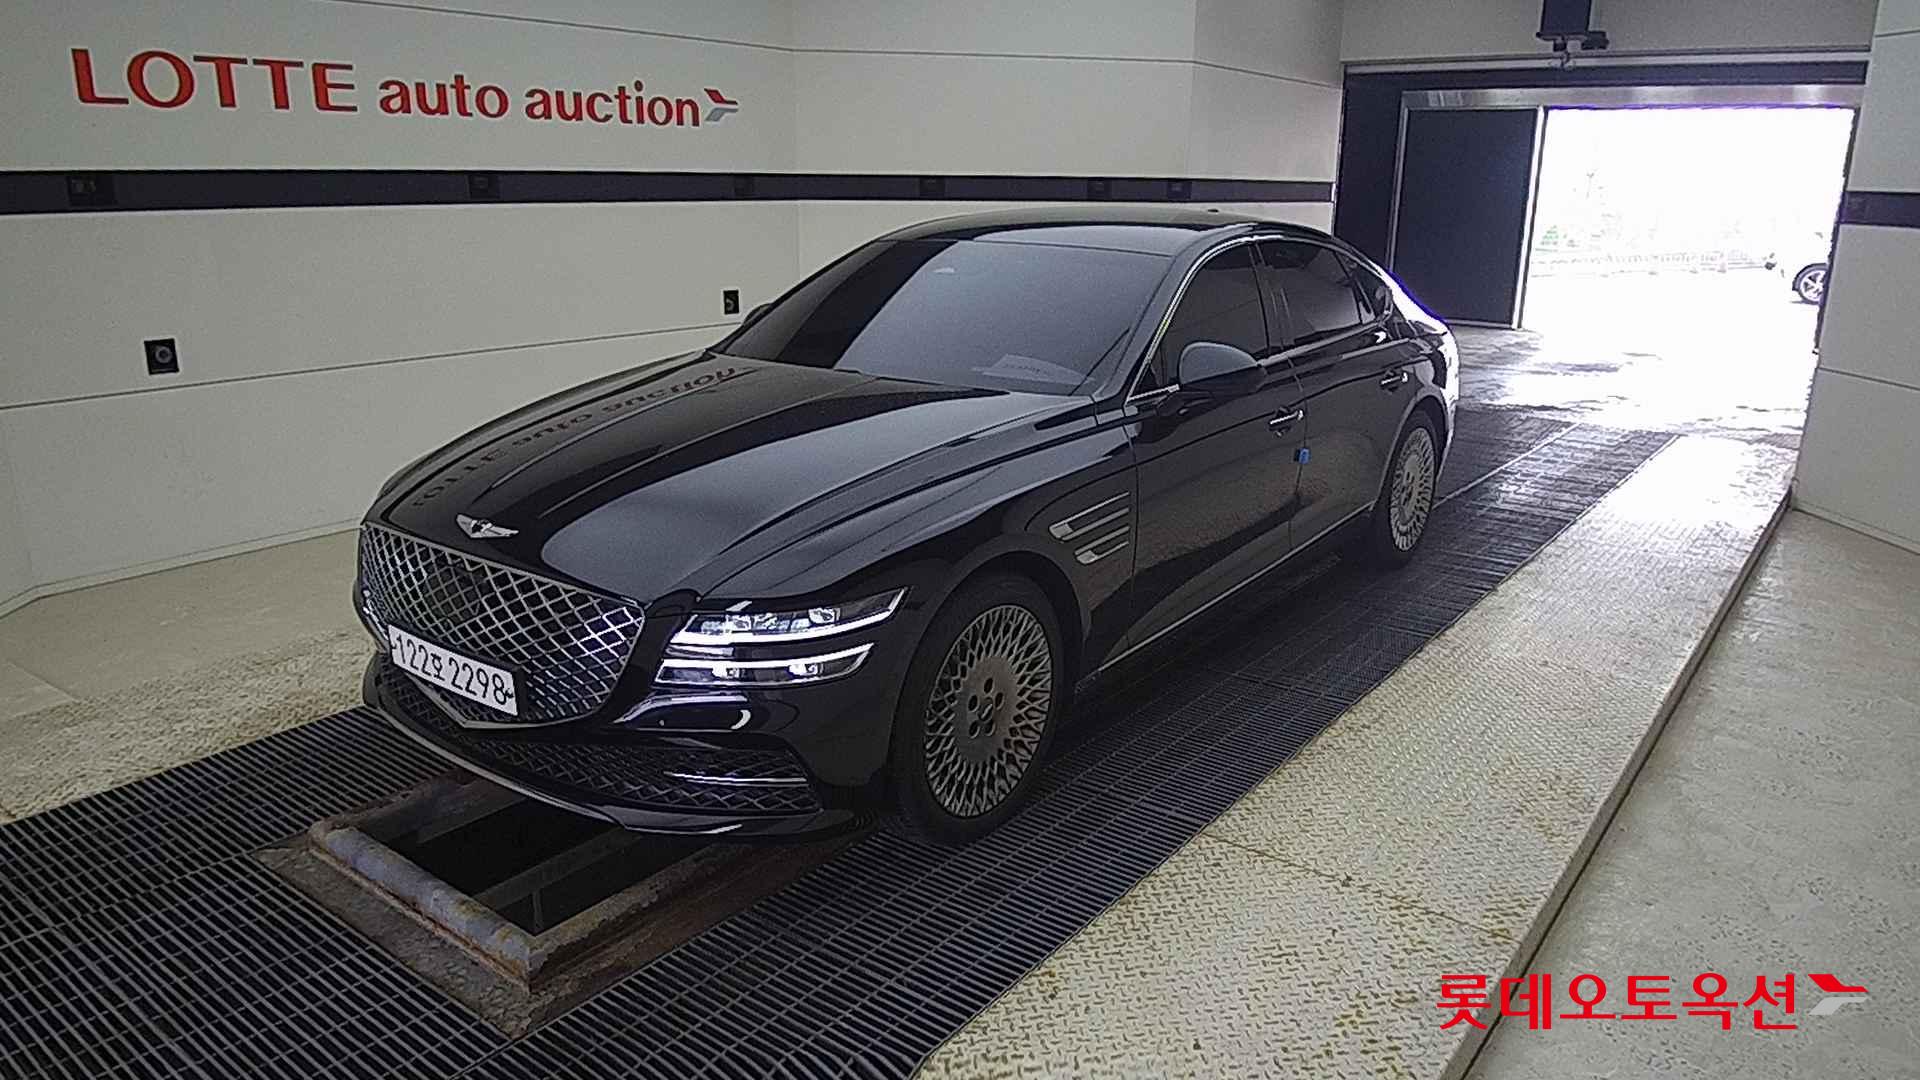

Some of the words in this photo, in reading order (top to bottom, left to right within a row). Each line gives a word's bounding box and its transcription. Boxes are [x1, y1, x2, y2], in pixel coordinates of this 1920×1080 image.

[71, 47, 358, 112] LOTTE
[378, 74, 508, 119] auto
[524, 80, 700, 127] auction
[396, 634, 445, 682] 122호
[449, 656, 507, 705] 2298
